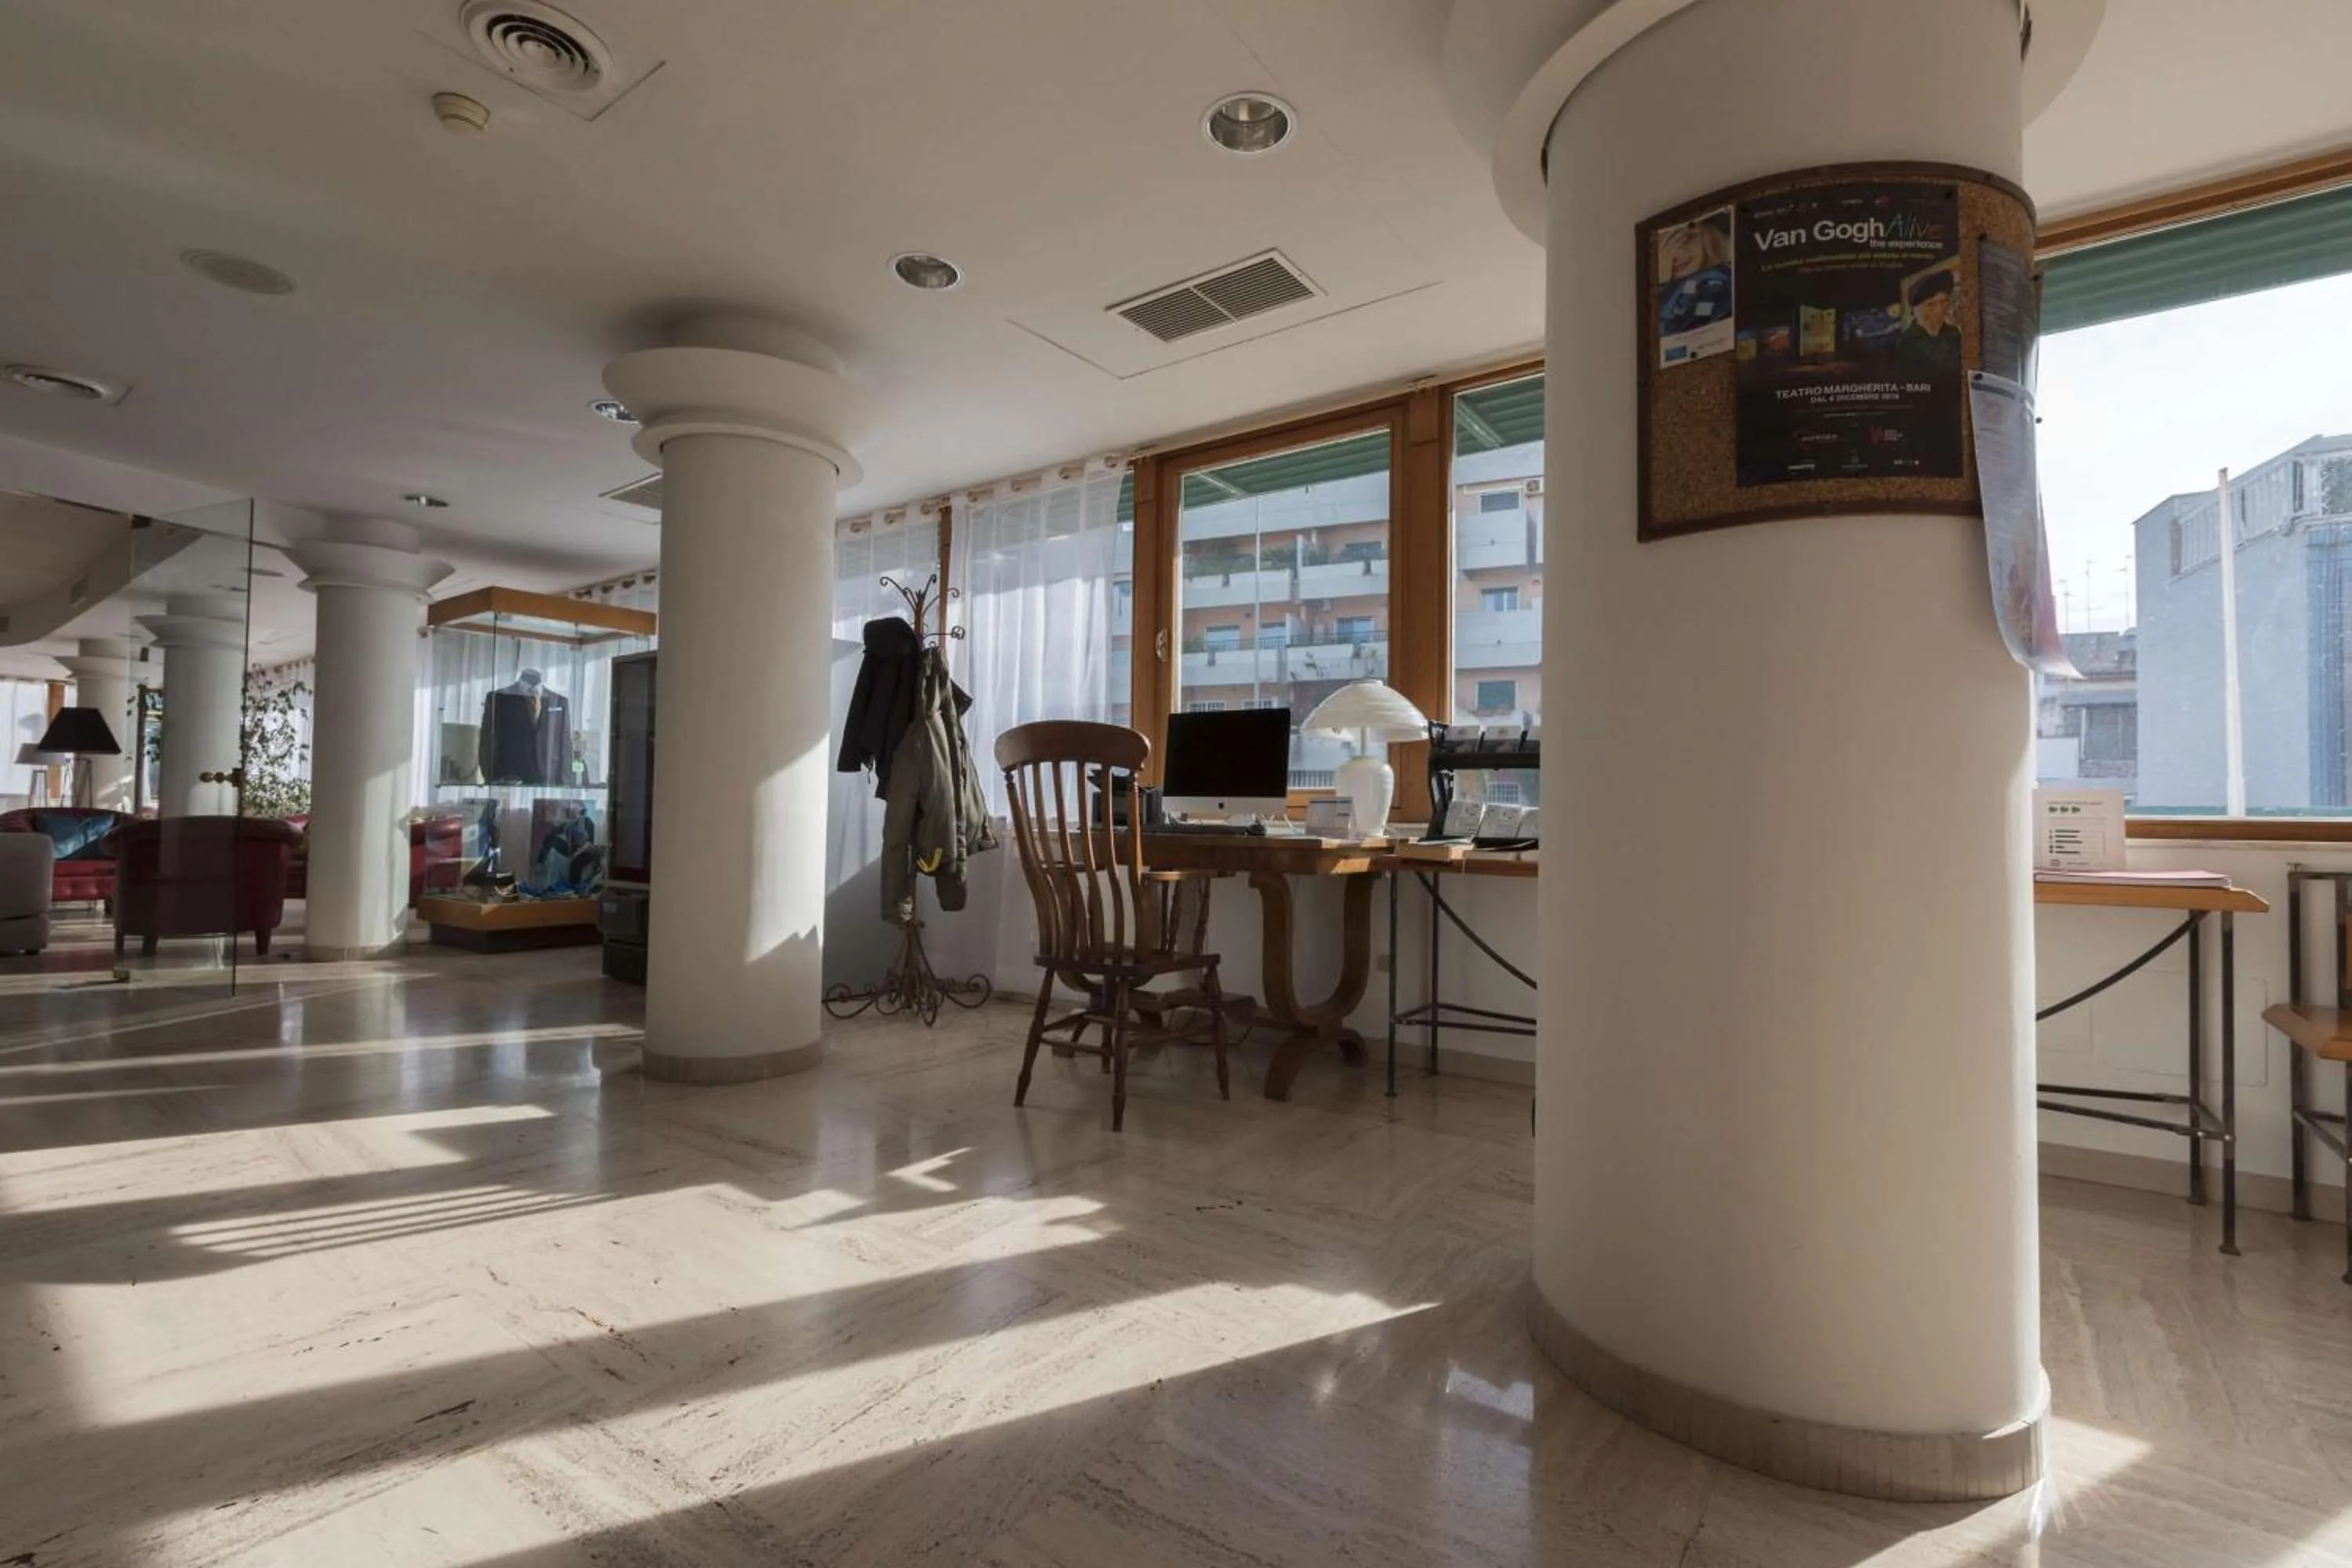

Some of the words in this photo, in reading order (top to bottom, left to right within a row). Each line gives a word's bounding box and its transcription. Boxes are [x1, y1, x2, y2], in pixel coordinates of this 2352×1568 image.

[1754, 228, 1806, 251] Van
[1813, 217, 1885, 244] Gogh
[1870, 238, 1886, 249] the
[1888, 240, 1944, 250] experience
[1776, 387, 1822, 399] TEATRO
[1823, 383, 1897, 394] MARGHERITA
[1906, 383, 1931, 393] BARI
